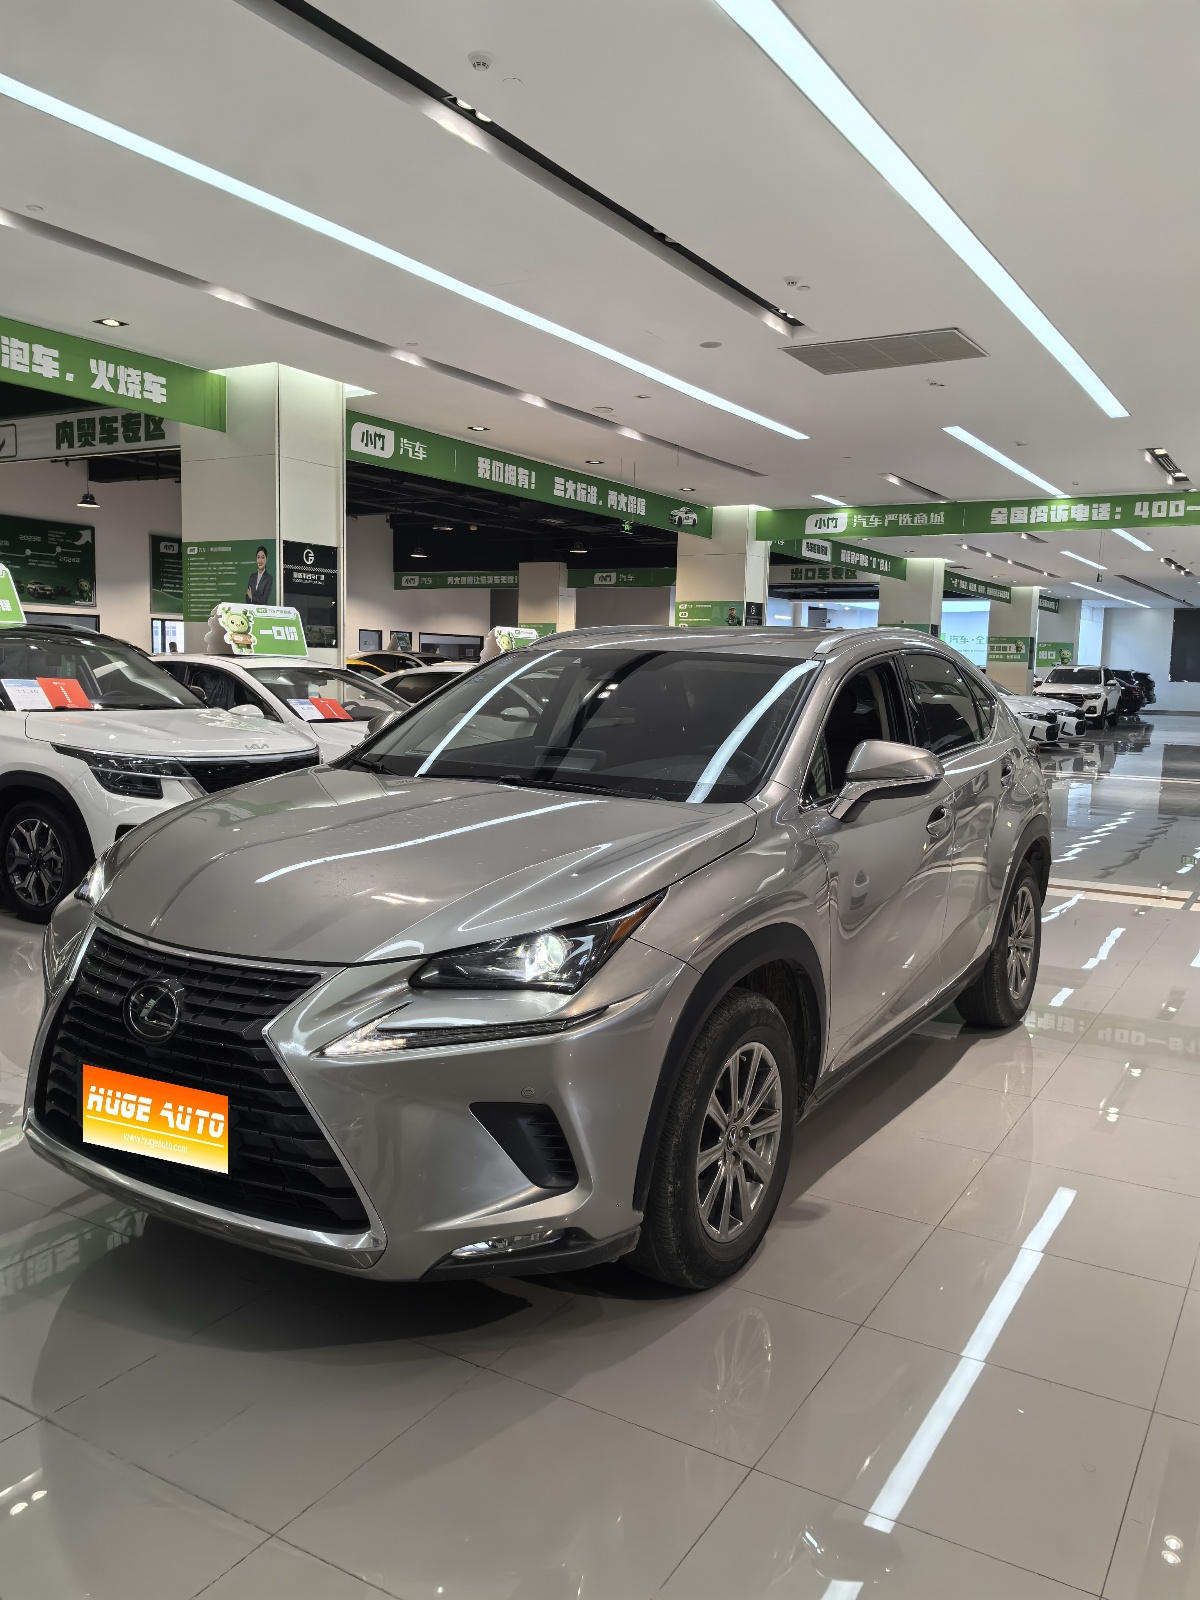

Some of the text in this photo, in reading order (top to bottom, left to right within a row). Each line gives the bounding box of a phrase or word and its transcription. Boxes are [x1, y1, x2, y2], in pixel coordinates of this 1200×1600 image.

[361, 430, 428, 461] 小竹 汽车
[814, 511, 945, 530] 小竹 汽车严选商城
[790, 567, 858, 581] 出口车专区
